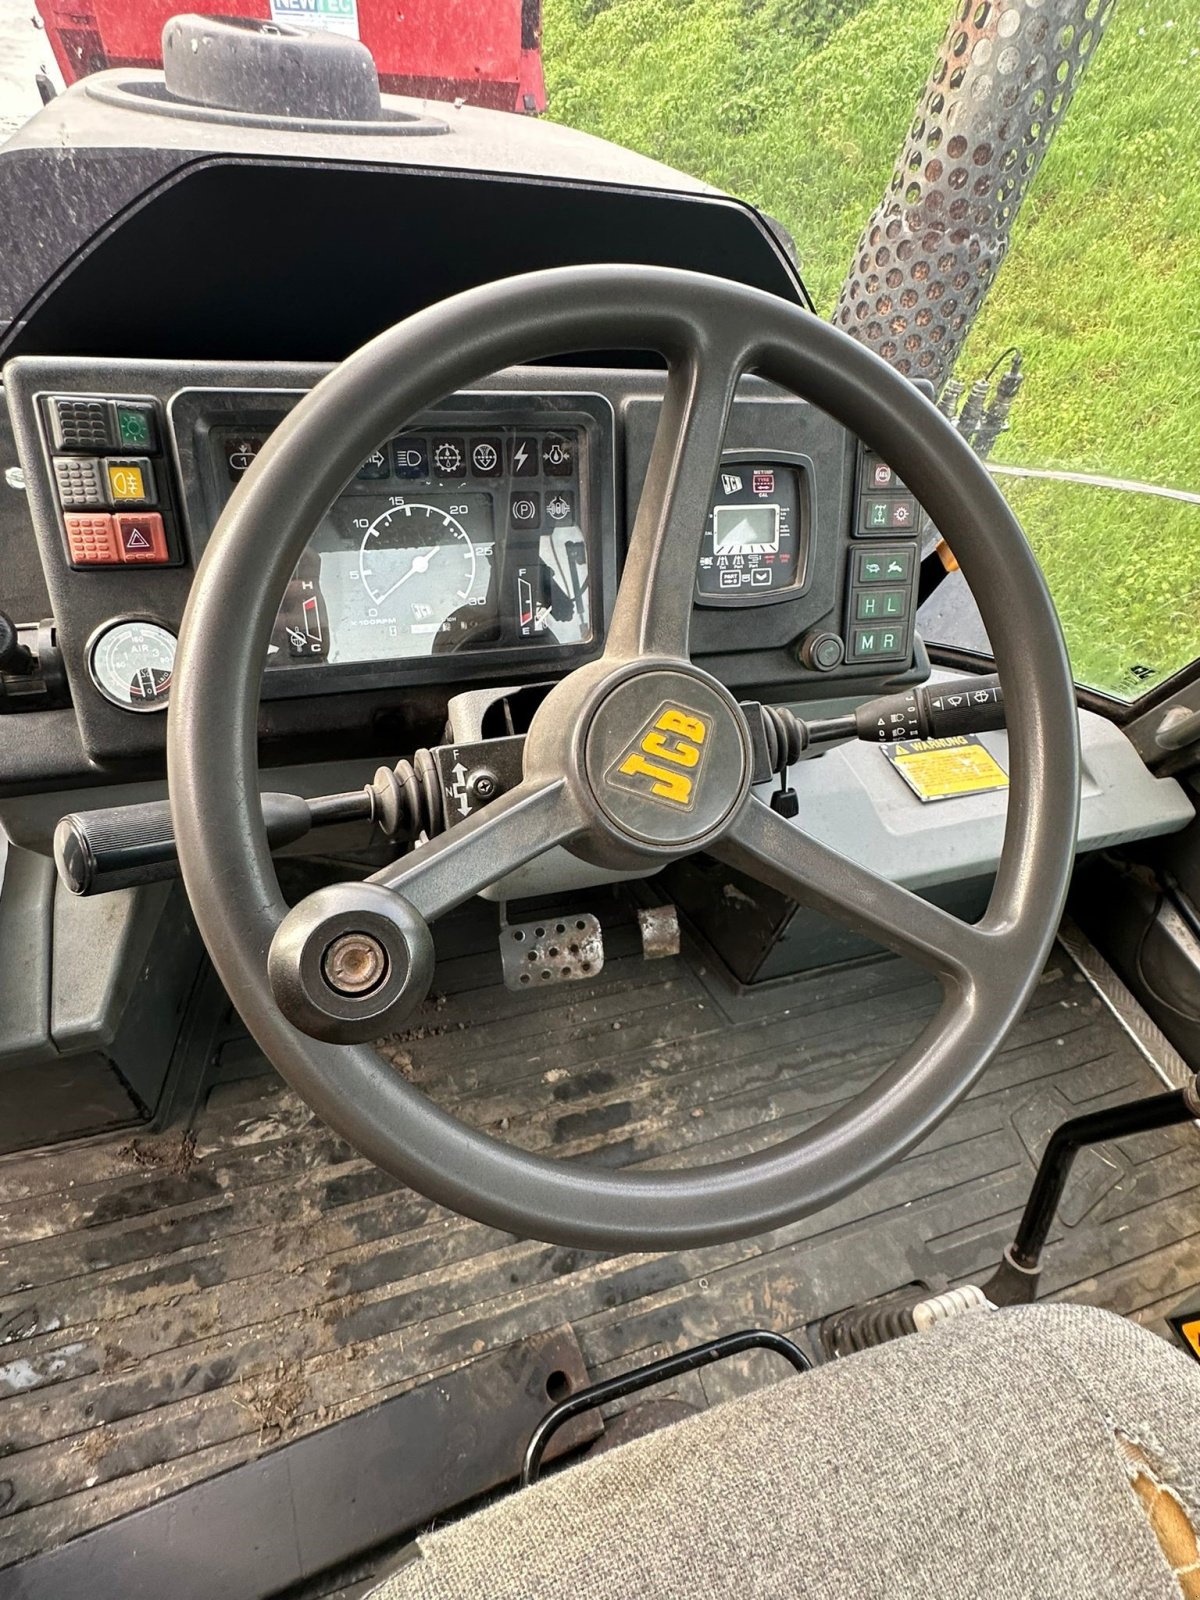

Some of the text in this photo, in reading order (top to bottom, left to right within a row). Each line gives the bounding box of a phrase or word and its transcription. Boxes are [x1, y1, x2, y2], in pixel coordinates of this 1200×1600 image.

[276, 0, 351, 11] NEWTEC
[389, 497, 404, 505] 15
[450, 505, 468, 514] 20
[353, 518, 369, 528] 10
[475, 547, 493, 556] 25
[350, 570, 360, 580] 5
[518, 568, 526, 577] F
[302, 581, 314, 590] H
[469, 597, 486, 606] 30
[865, 598, 896, 613] H L
[522, 627, 530, 635] E
[861, 634, 894, 649] M R
[131, 644, 149, 653] AIR
[311, 643, 321, 652] C
[452, 749, 460, 760] F
[619, 710, 706, 804] JCB
[445, 786, 453, 797] N
